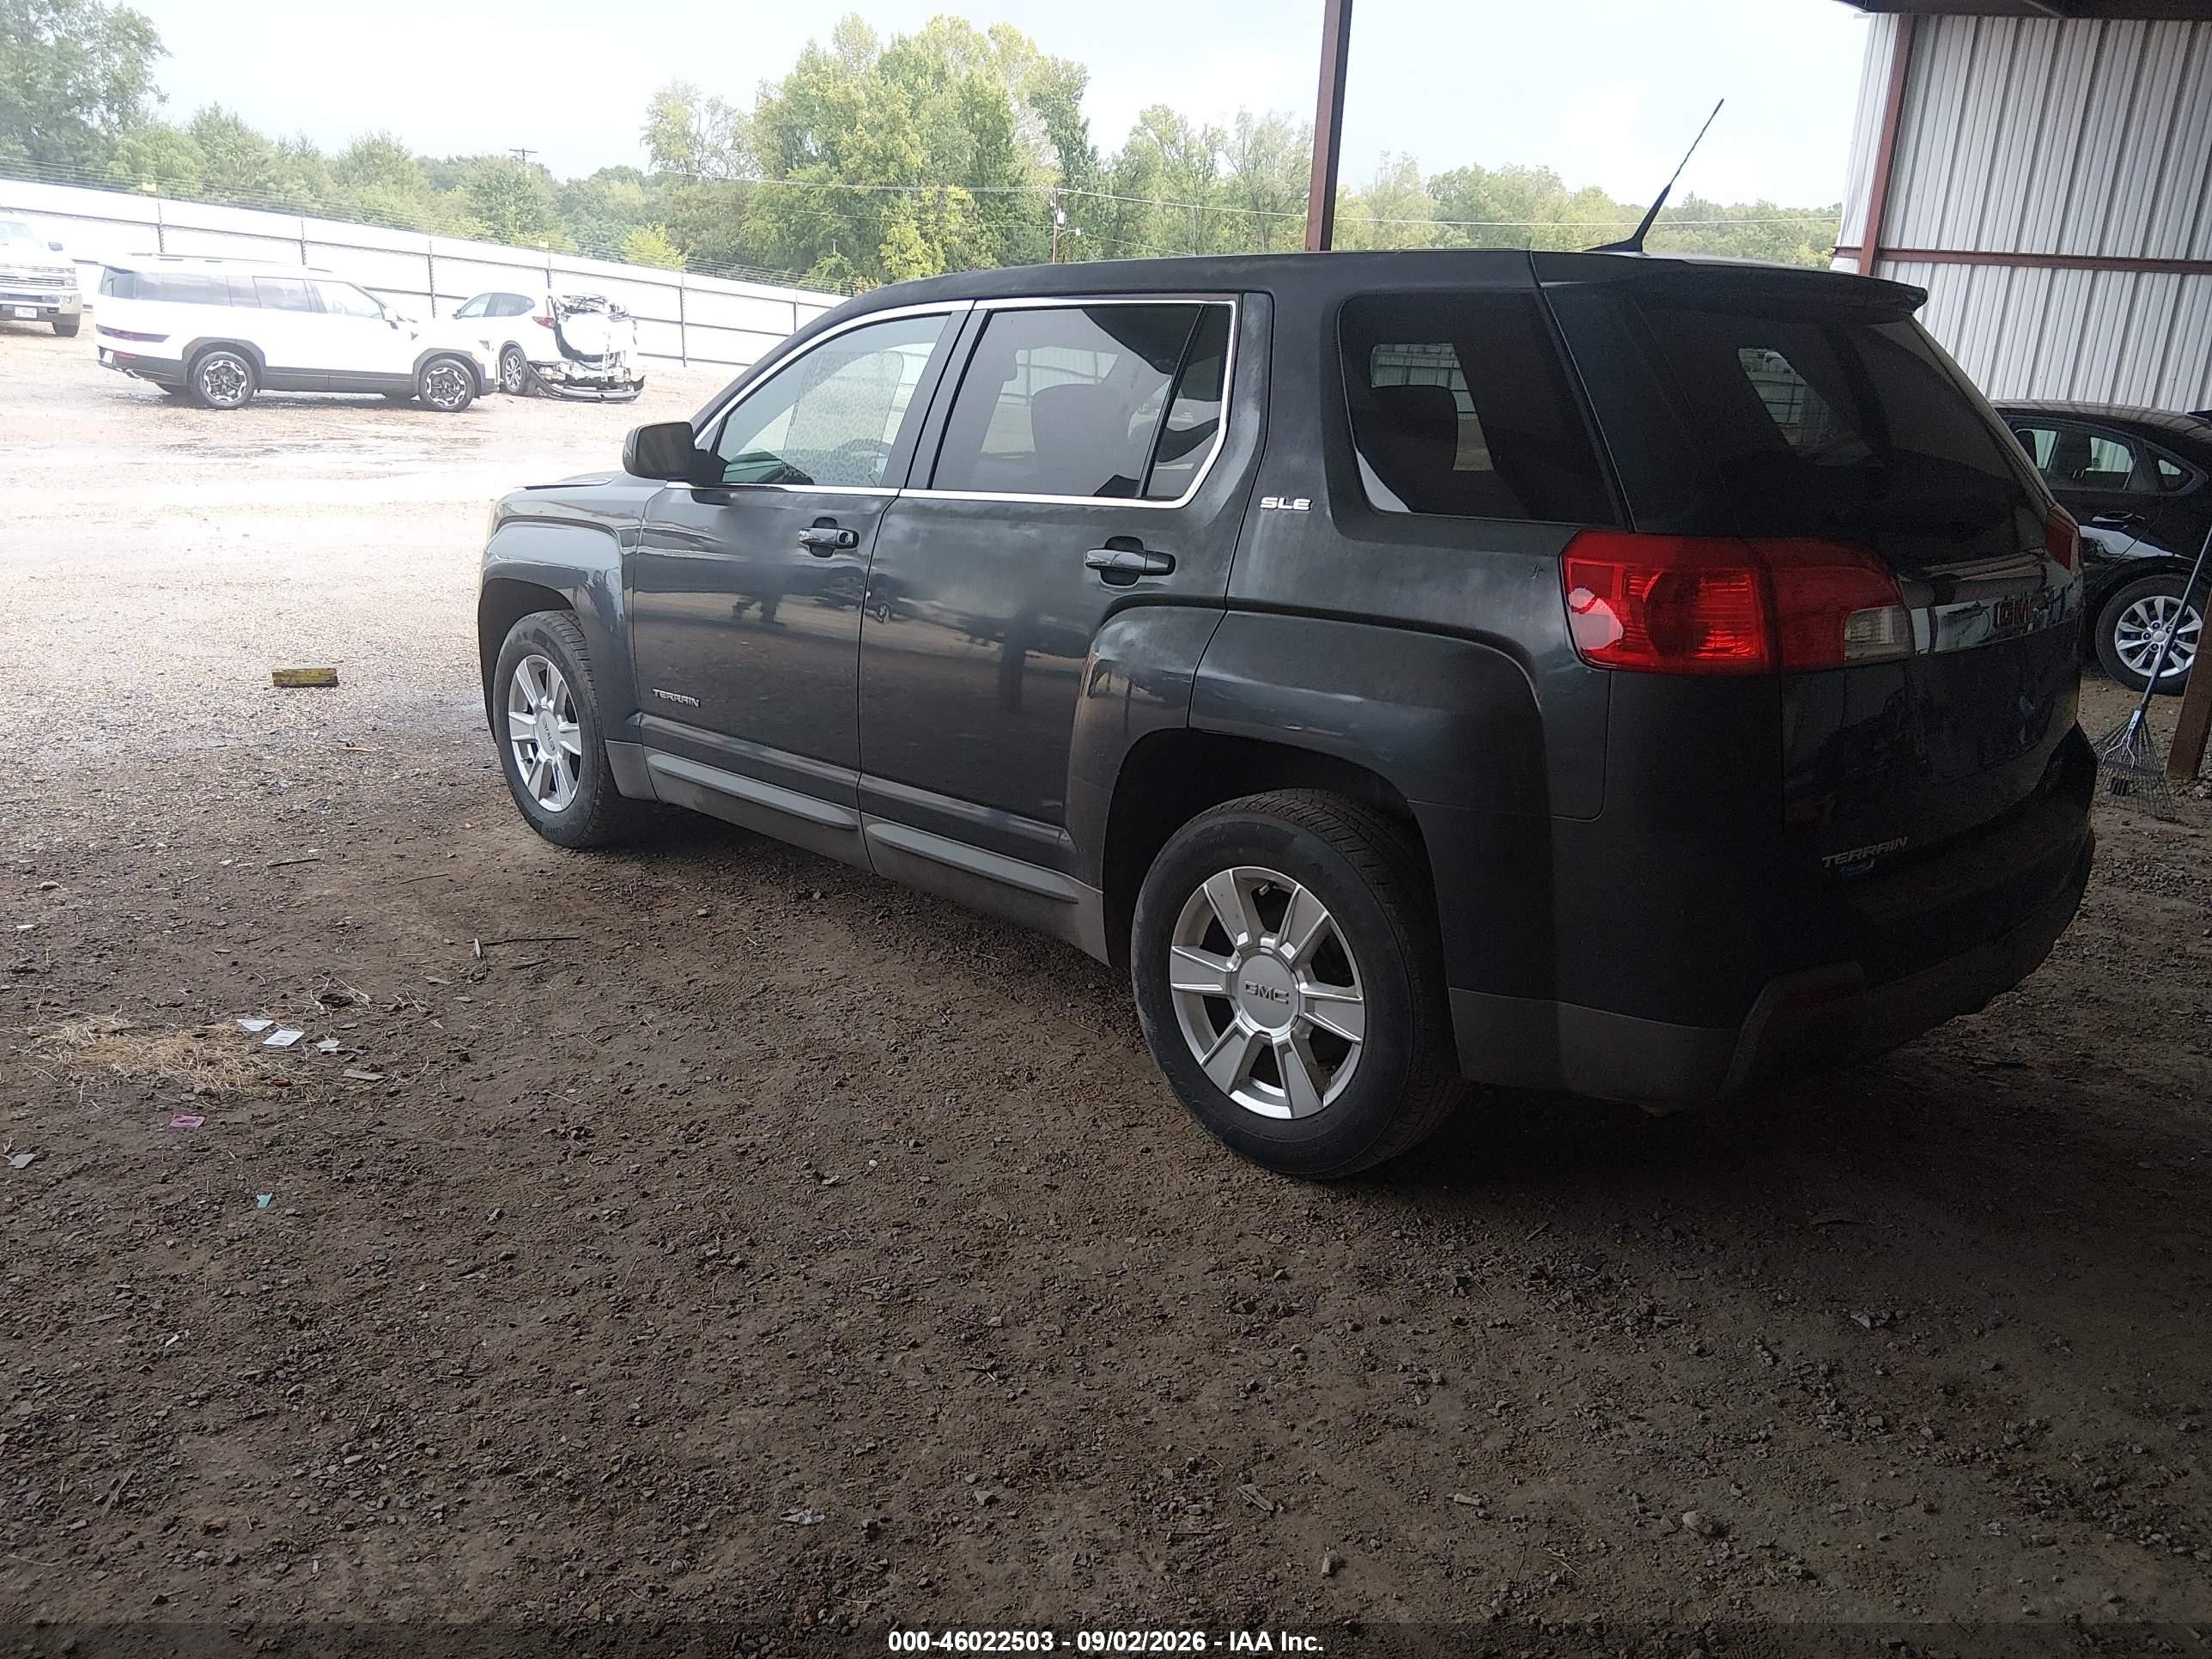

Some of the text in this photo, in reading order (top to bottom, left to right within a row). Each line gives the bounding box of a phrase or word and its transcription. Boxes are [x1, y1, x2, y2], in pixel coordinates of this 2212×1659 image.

[1260, 496, 1312, 511] SLE
[653, 688, 701, 708] TERRAIN
[1821, 836, 1909, 868] TERRAIN
[1243, 980, 1290, 1005] GMC
